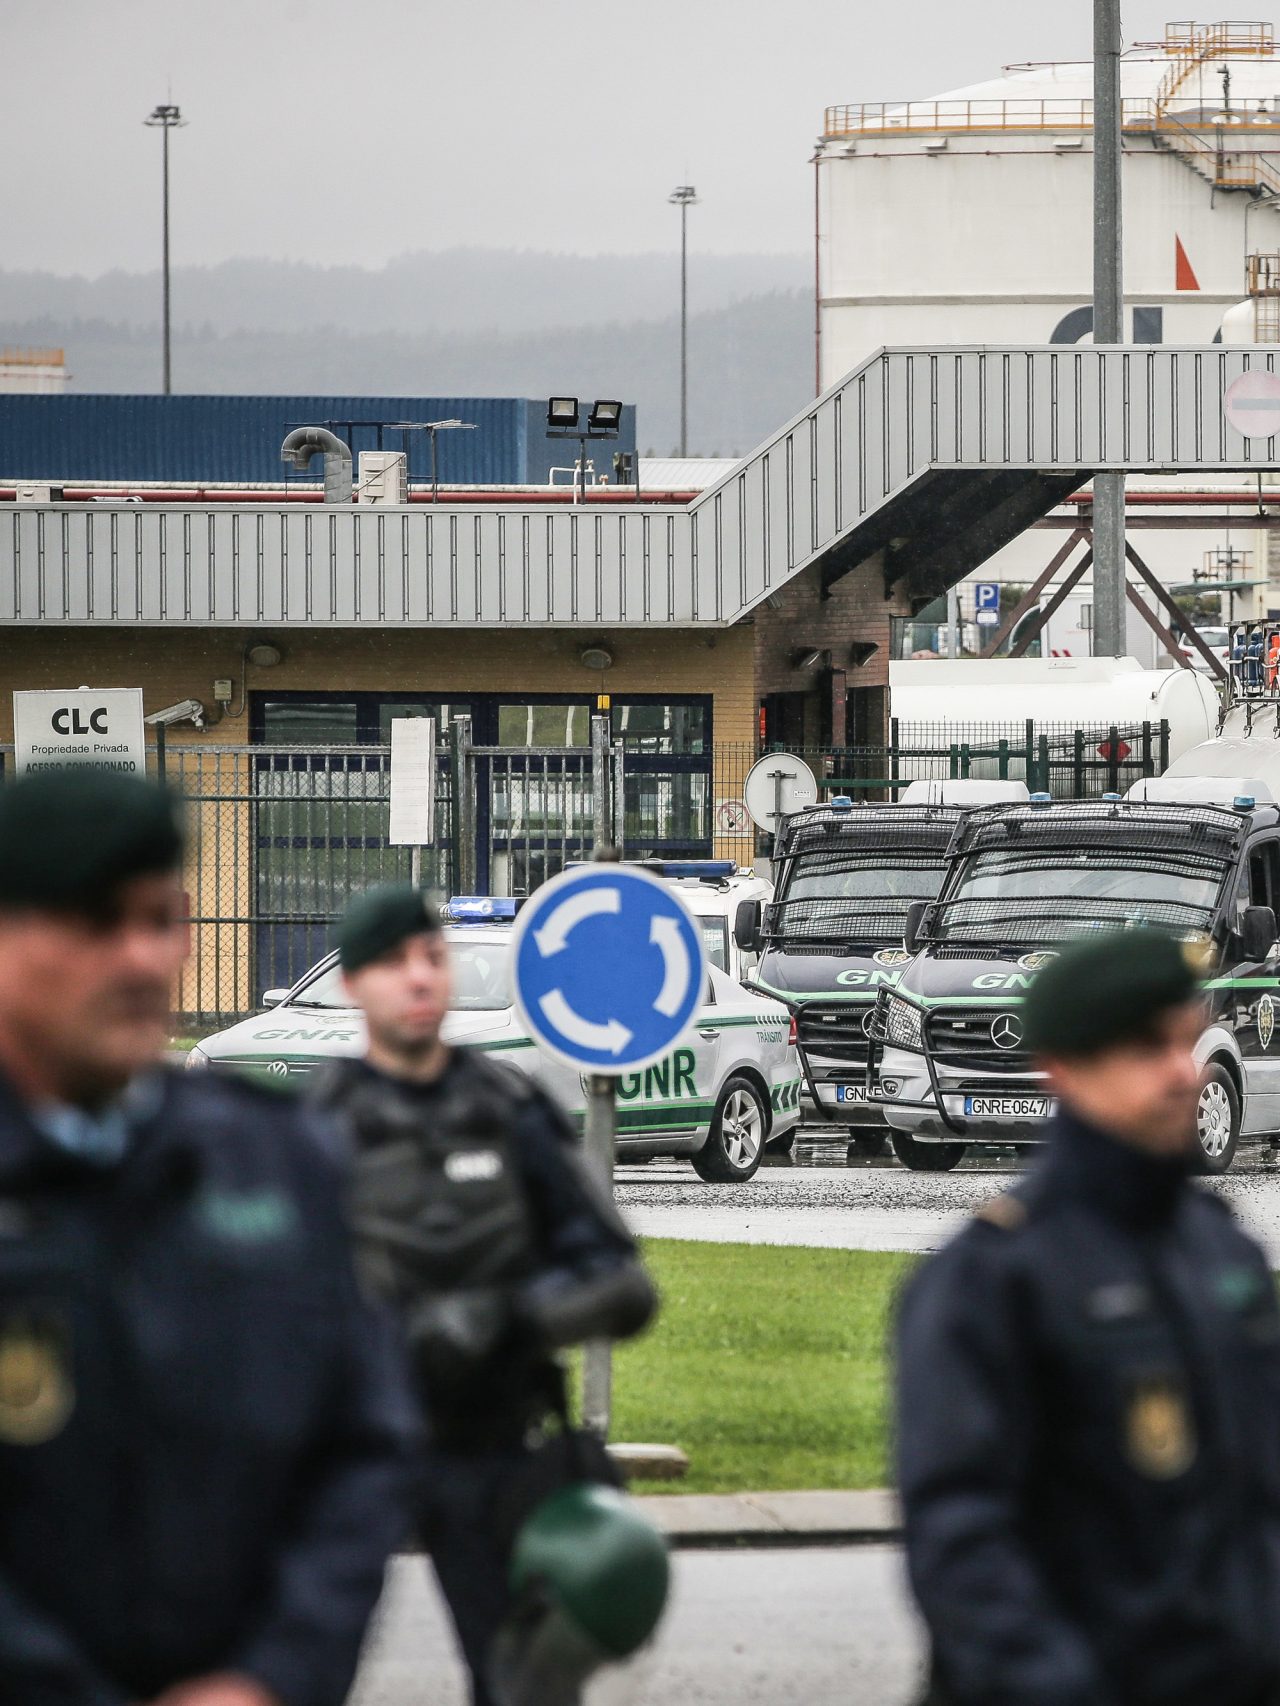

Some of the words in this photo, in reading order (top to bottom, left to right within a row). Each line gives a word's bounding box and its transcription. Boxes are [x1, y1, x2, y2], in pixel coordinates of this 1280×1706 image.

[980, 586, 995, 606] P
[51, 707, 108, 735] CLC
[31, 745, 90, 755] Propriedade
[93, 744, 129, 753] Privada
[836, 969, 904, 985] GN
[252, 1029, 359, 1041] GNR
[616, 1049, 698, 1100] GNR
